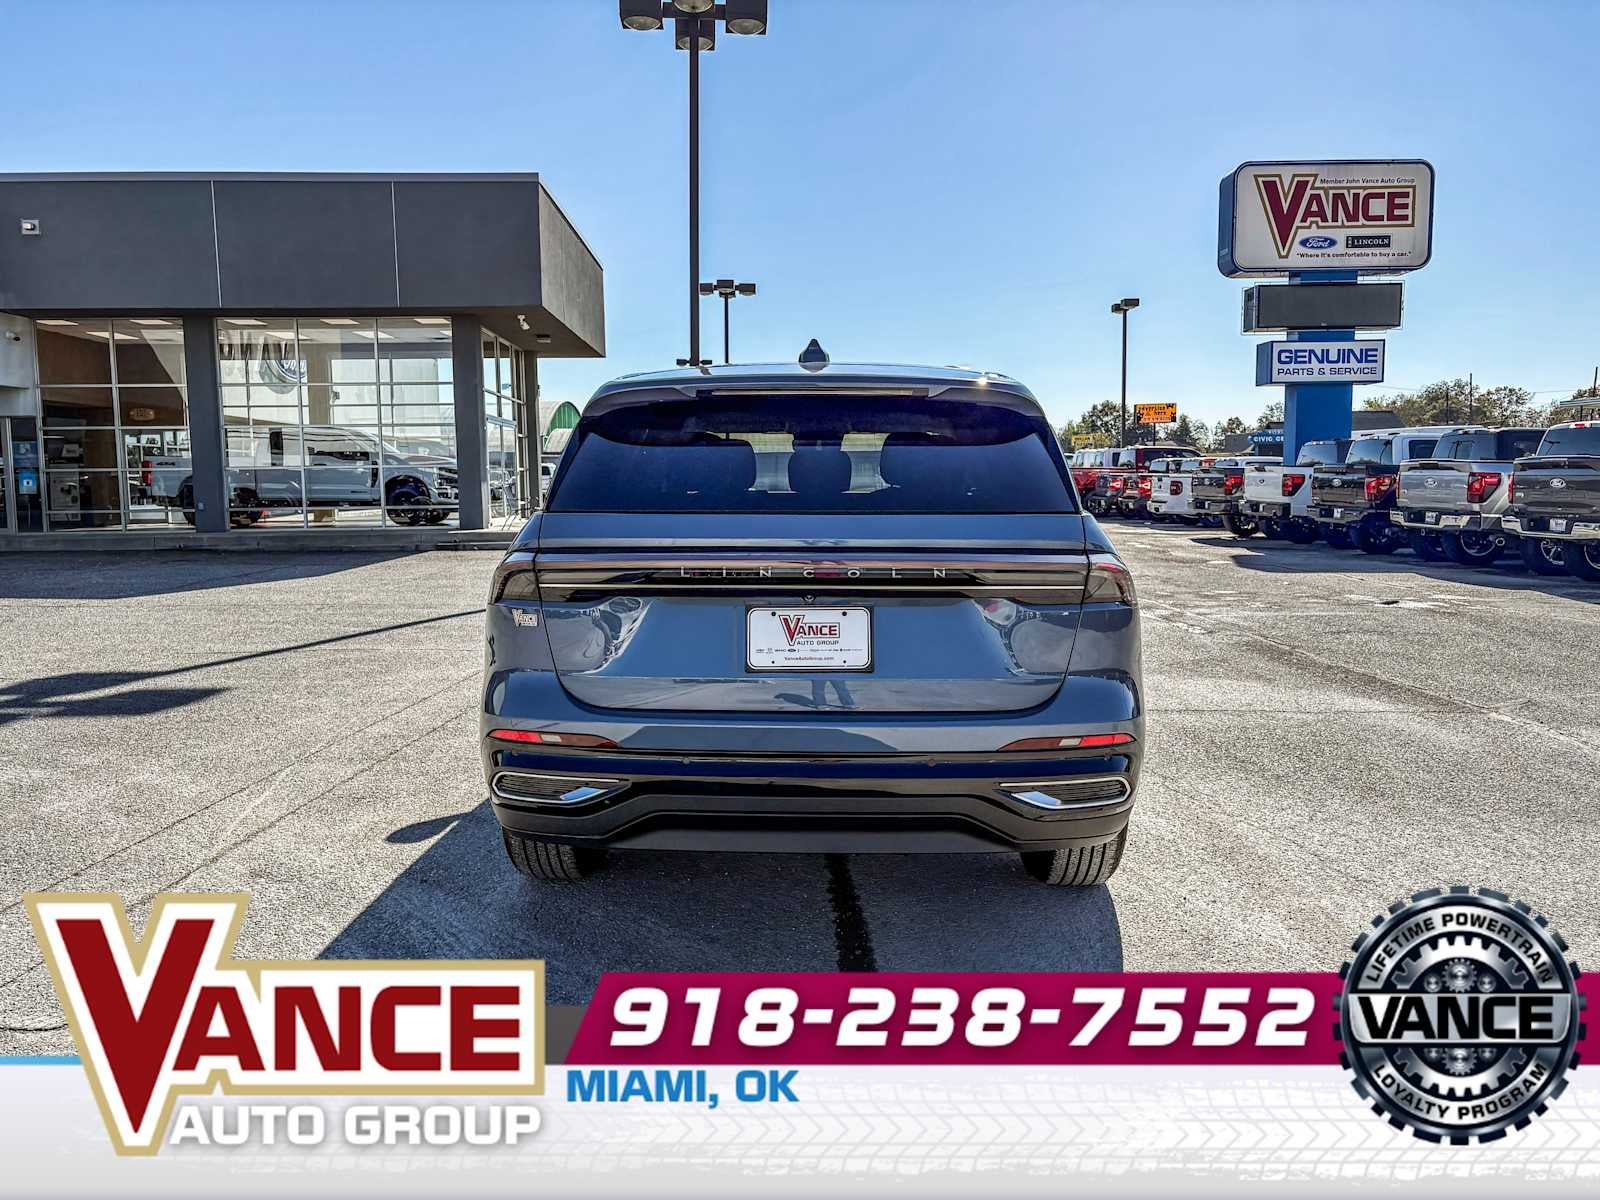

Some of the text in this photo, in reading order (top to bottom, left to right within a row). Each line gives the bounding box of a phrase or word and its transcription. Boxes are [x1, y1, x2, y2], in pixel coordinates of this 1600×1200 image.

[1396, 177, 1416, 185] Group
[1306, 237, 1331, 249] Ford
[1353, 237, 1390, 246] LINCOLN
[1277, 348, 1379, 365] GENUINE
[1277, 367, 1378, 376] PARTS & SERVICE
[679, 567, 946, 579] LINCOLN
[782, 617, 839, 643] VANCE
